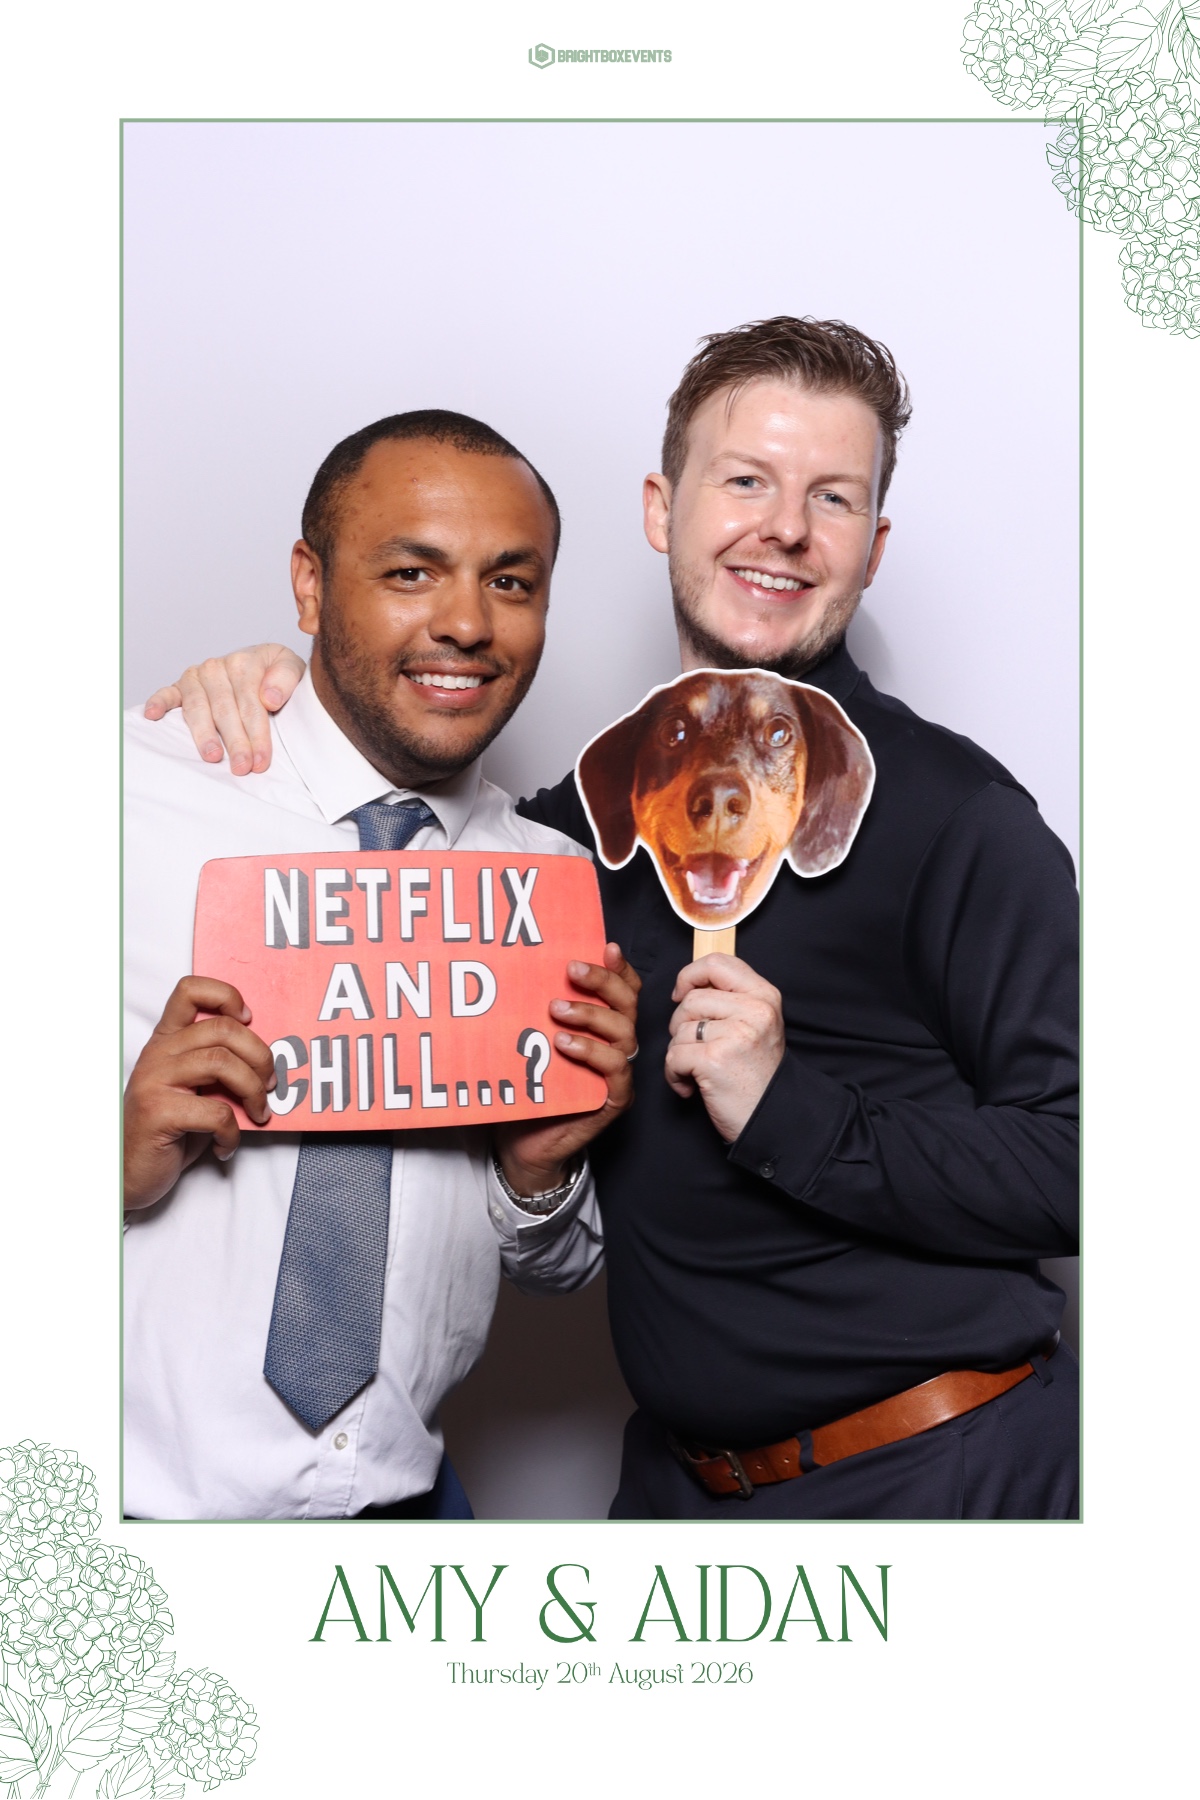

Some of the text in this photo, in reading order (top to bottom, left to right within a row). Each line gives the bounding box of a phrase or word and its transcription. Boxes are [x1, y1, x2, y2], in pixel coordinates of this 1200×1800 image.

[263, 867, 543, 949] NETFLIX
[317, 960, 498, 1021] AND
[267, 1027, 551, 1116] CHILL...?
